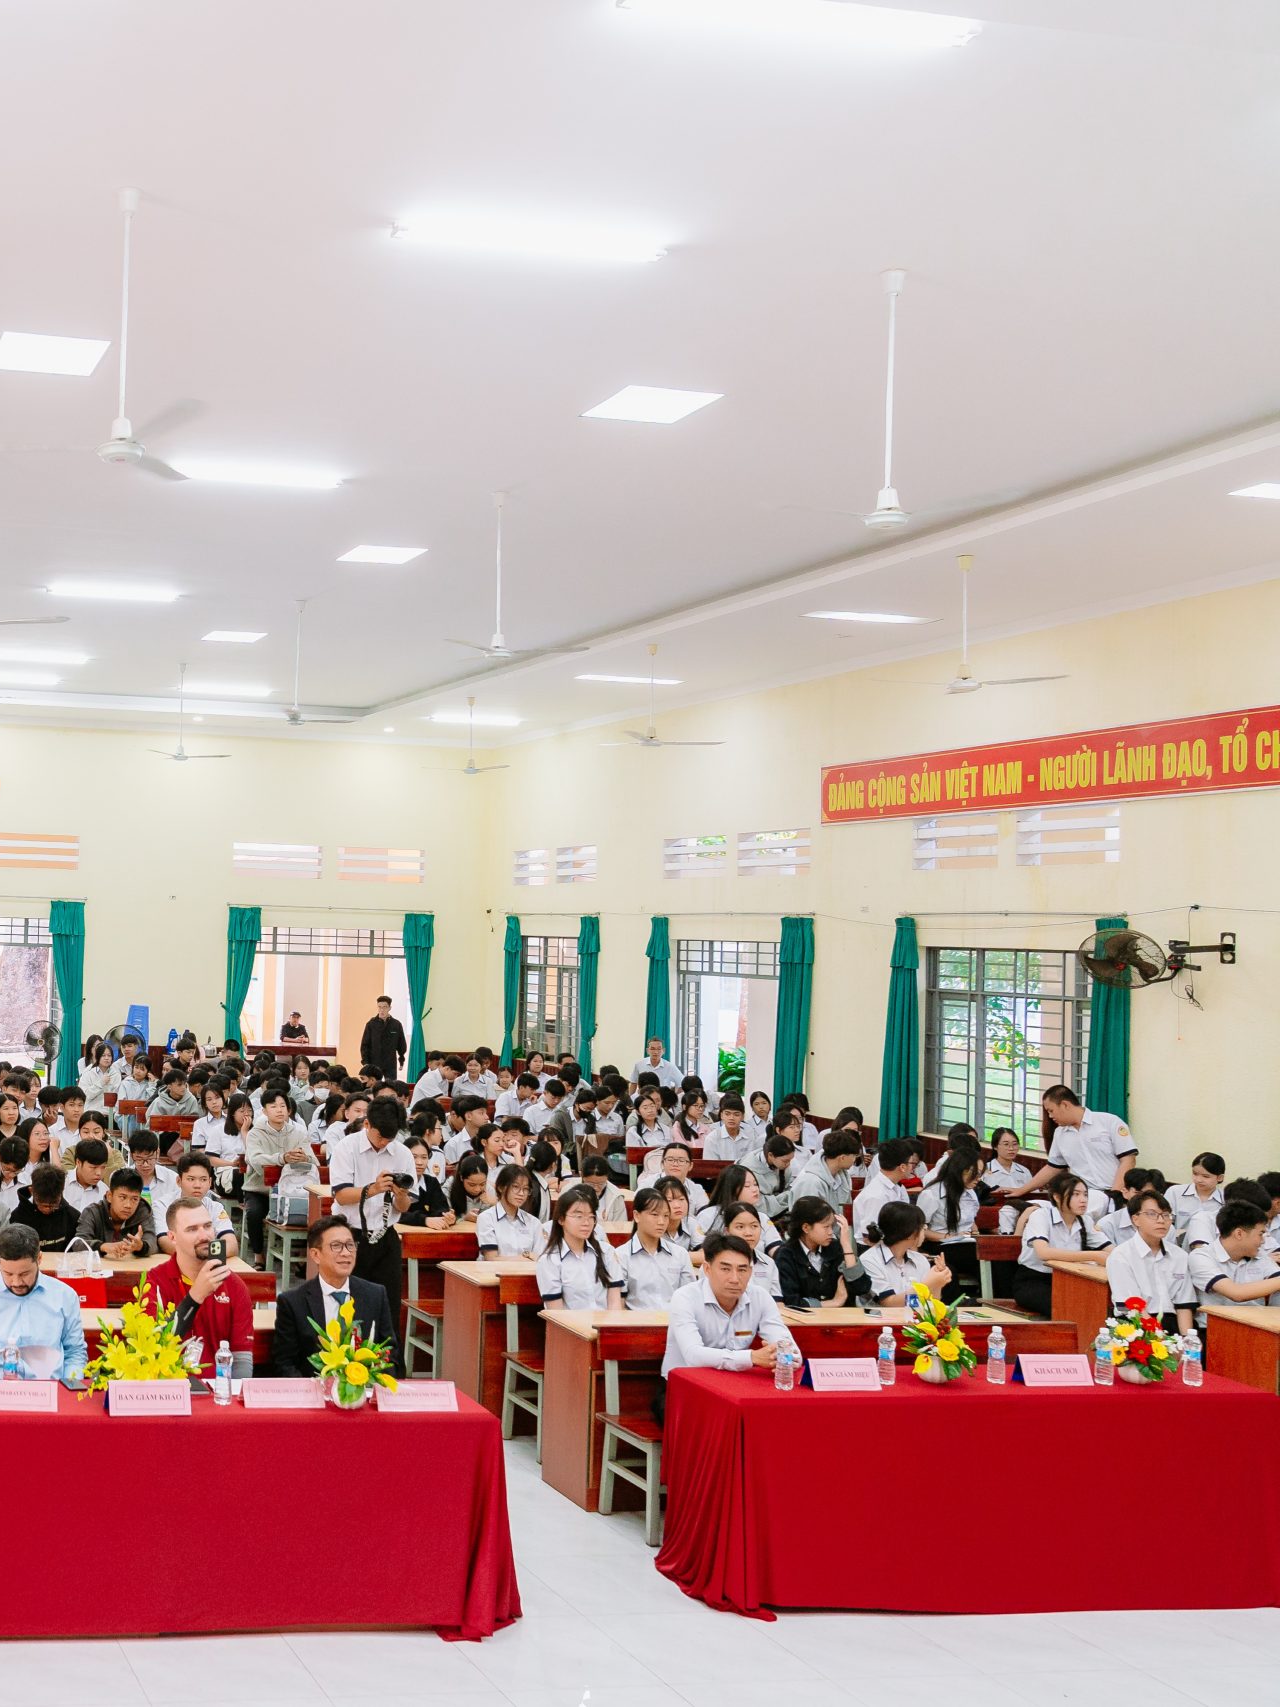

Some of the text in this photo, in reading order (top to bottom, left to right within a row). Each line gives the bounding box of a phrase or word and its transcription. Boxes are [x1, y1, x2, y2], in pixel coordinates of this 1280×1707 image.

[827, 772, 865, 812] ĐẢNG
[867, 772, 906, 814] CỘNG
[910, 760, 942, 804] SẢN
[945, 760, 980, 806] VIỆT
[982, 760, 1022, 797] NAM
[1027, 774, 1035, 782] -
[1040, 743, 1098, 793] NGƯỜI
[1102, 741, 1157, 785] LÃNH
[1162, 739, 1213, 788] ĐẠO,
[1219, 717, 1249, 774] TỔ
[118, 1393, 135, 1401] BAN
